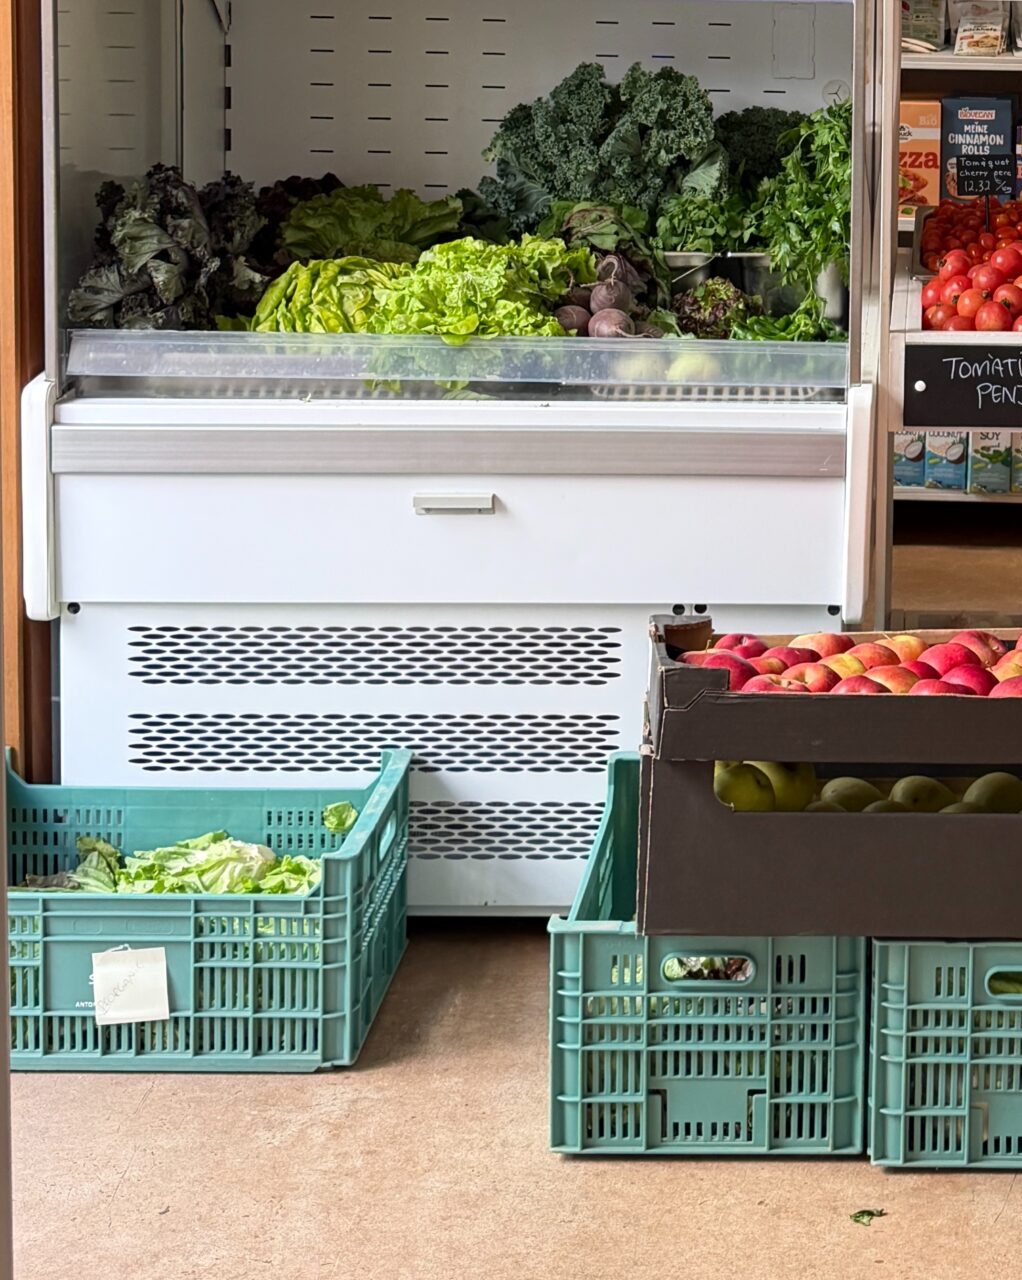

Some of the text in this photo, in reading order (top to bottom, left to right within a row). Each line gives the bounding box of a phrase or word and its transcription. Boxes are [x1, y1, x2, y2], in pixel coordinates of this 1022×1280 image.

[964, 124, 988, 133] MEINE
[948, 133, 1004, 145] CINNAMON
[961, 144, 990, 155] ROLLS
[960, 169, 988, 177] cherry
[980, 431, 1000, 441] SOY
